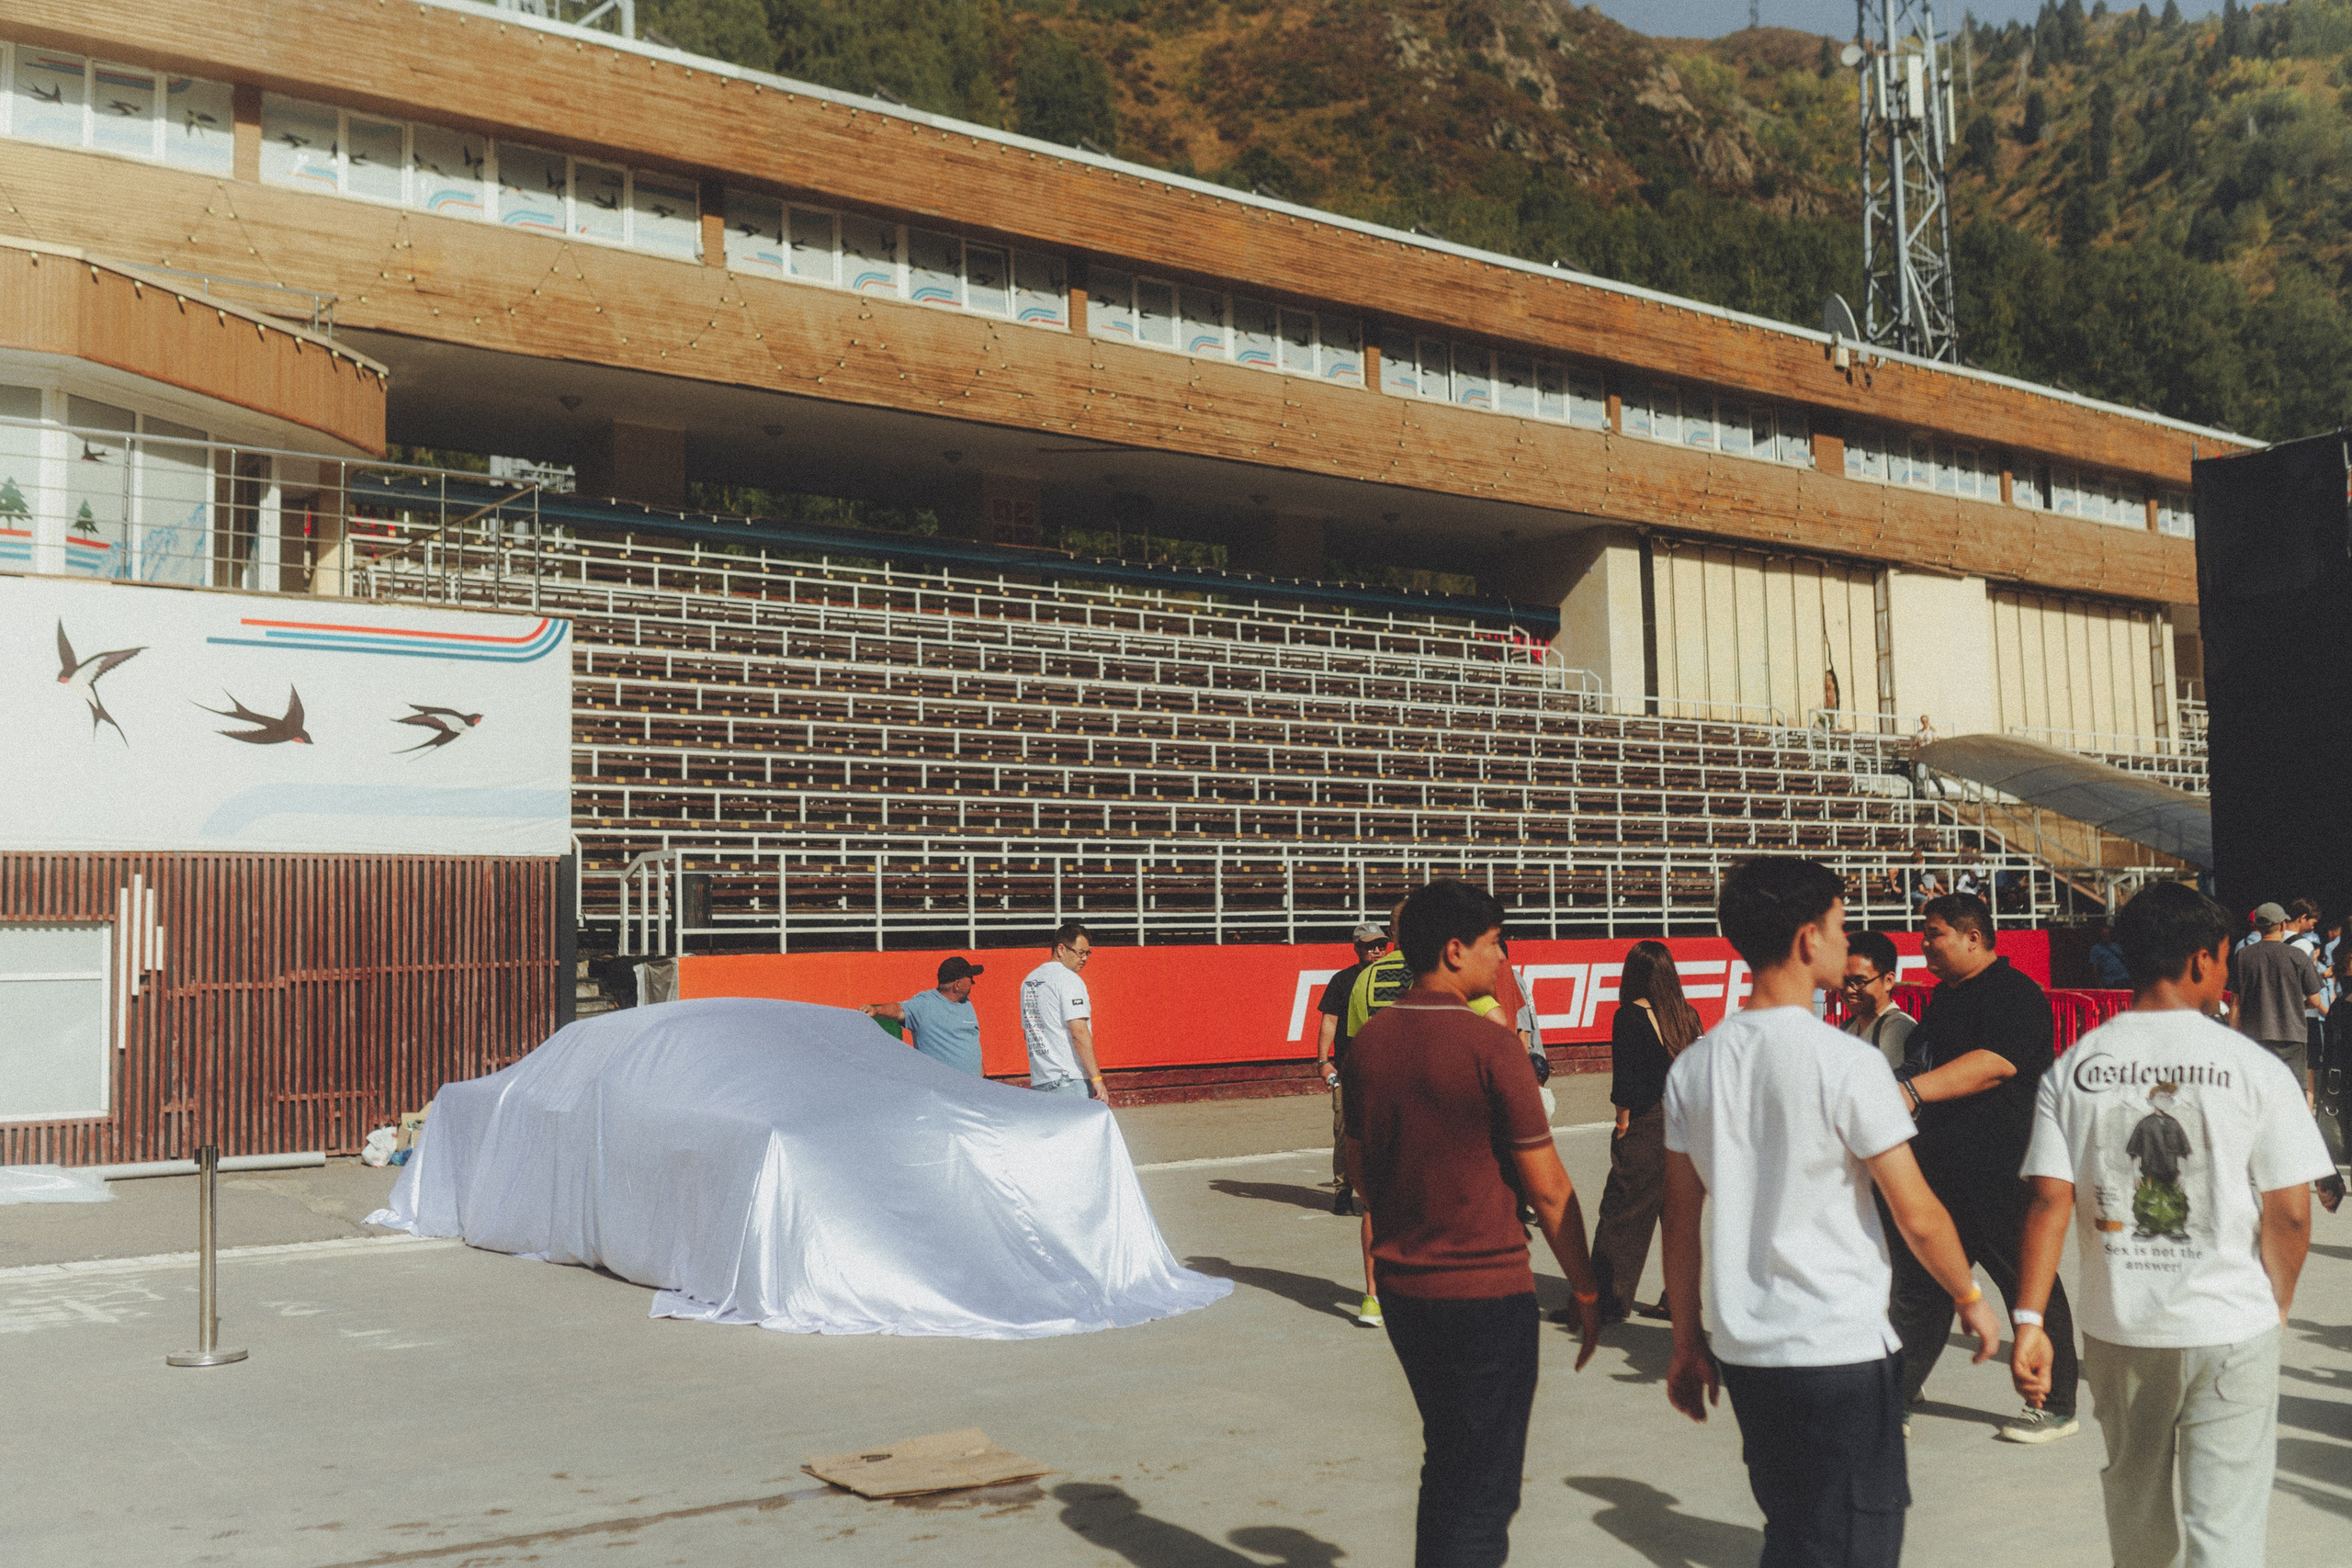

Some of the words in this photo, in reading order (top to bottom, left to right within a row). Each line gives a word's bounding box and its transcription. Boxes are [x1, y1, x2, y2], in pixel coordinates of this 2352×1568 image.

[2073, 1053, 2231, 1092] Castlevania
[2104, 1243, 2129, 1256] Sex
[2134, 1245, 2147, 1256] is
[2151, 1247, 2176, 1258] not
[2180, 1247, 2203, 1260] the
